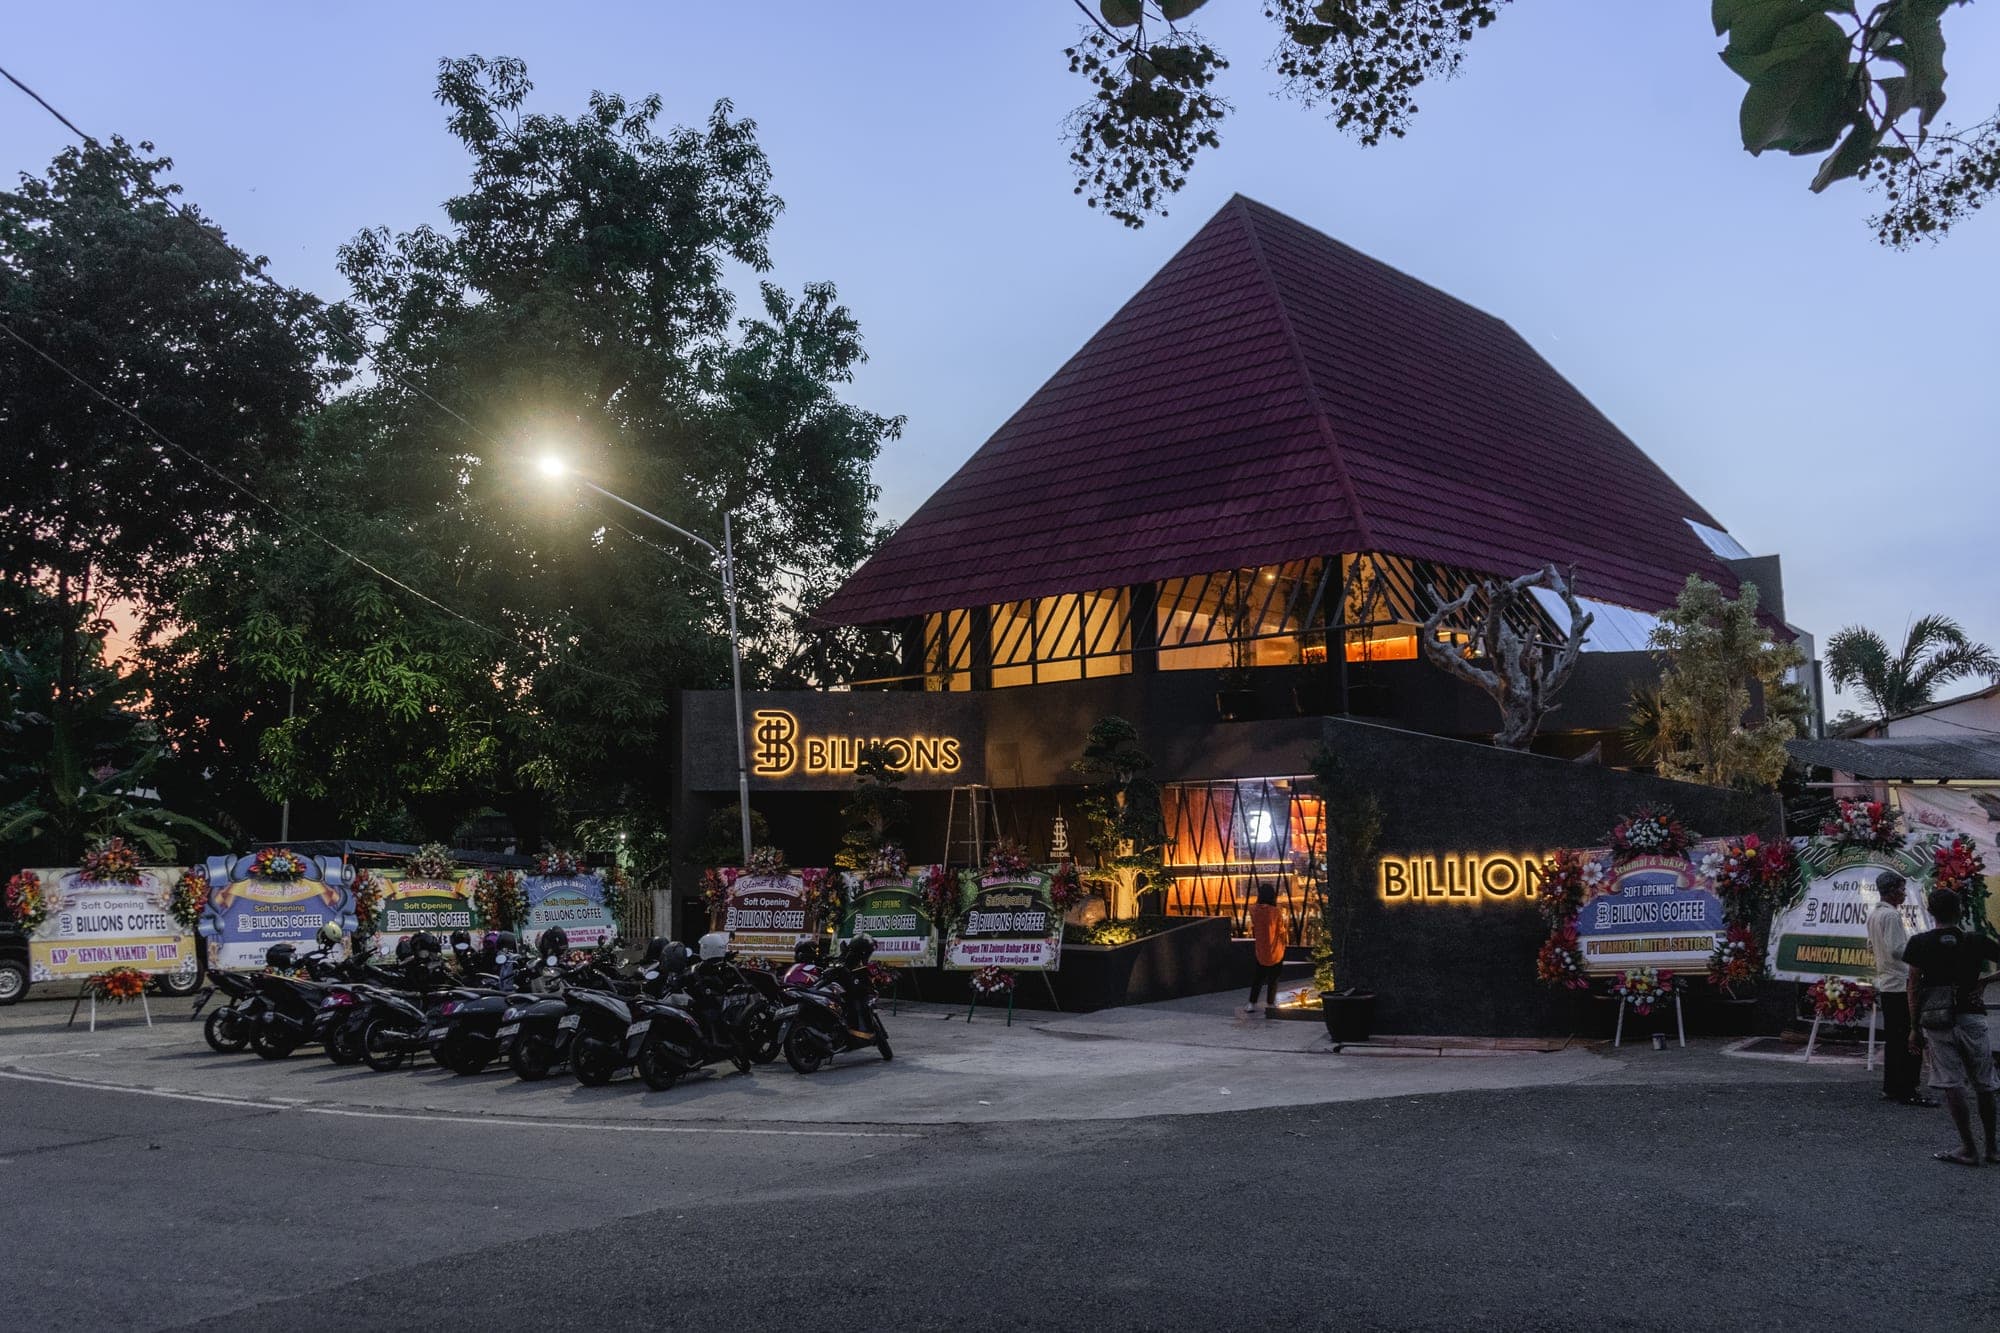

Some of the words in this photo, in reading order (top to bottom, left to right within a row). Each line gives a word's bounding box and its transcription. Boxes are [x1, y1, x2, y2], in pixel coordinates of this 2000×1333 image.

[808, 738, 960, 770] BILLONS
[1614, 858, 1648, 875] Selamat
[1659, 858, 1688, 871] Sukses
[1384, 859, 1544, 896] BILLION
[1624, 885, 1641, 898] SOFT
[1642, 884, 1675, 897] OPENING
[1832, 880, 1850, 892] Soft
[81, 901, 100, 910] Soft
[104, 900, 144, 911] Opening
[272, 904, 306, 913] Opening
[744, 898, 759, 906] Soft
[760, 898, 790, 908] Opening
[400, 913, 437, 928] BILLIONS
[439, 912, 470, 926] COFFEE
[544, 909, 575, 922] BILLIONS
[576, 908, 602, 920] COFFEE
[737, 910, 772, 928] BILLIONS
[773, 910, 805, 928] COFFEE
[1612, 903, 1658, 923] BILLIONS
[1661, 901, 1705, 921] COFFEE
[1820, 902, 1868, 925] BILLIONS
[76, 914, 124, 933] BILLIONS
[128, 913, 166, 930] COFFEE
[252, 917, 288, 928] BILLIONS
[291, 916, 322, 928] COFFEE
[863, 915, 890, 931] BILLIONS
[892, 914, 916, 930] COFFEE
[979, 913, 1012, 931] BILLIONS
[1012, 912, 1045, 930] COFFEE
[1672, 936, 1713, 952] SENTOSA
[52, 949, 68, 964] KSP
[1796, 946, 1839, 964] MAHKOTA
